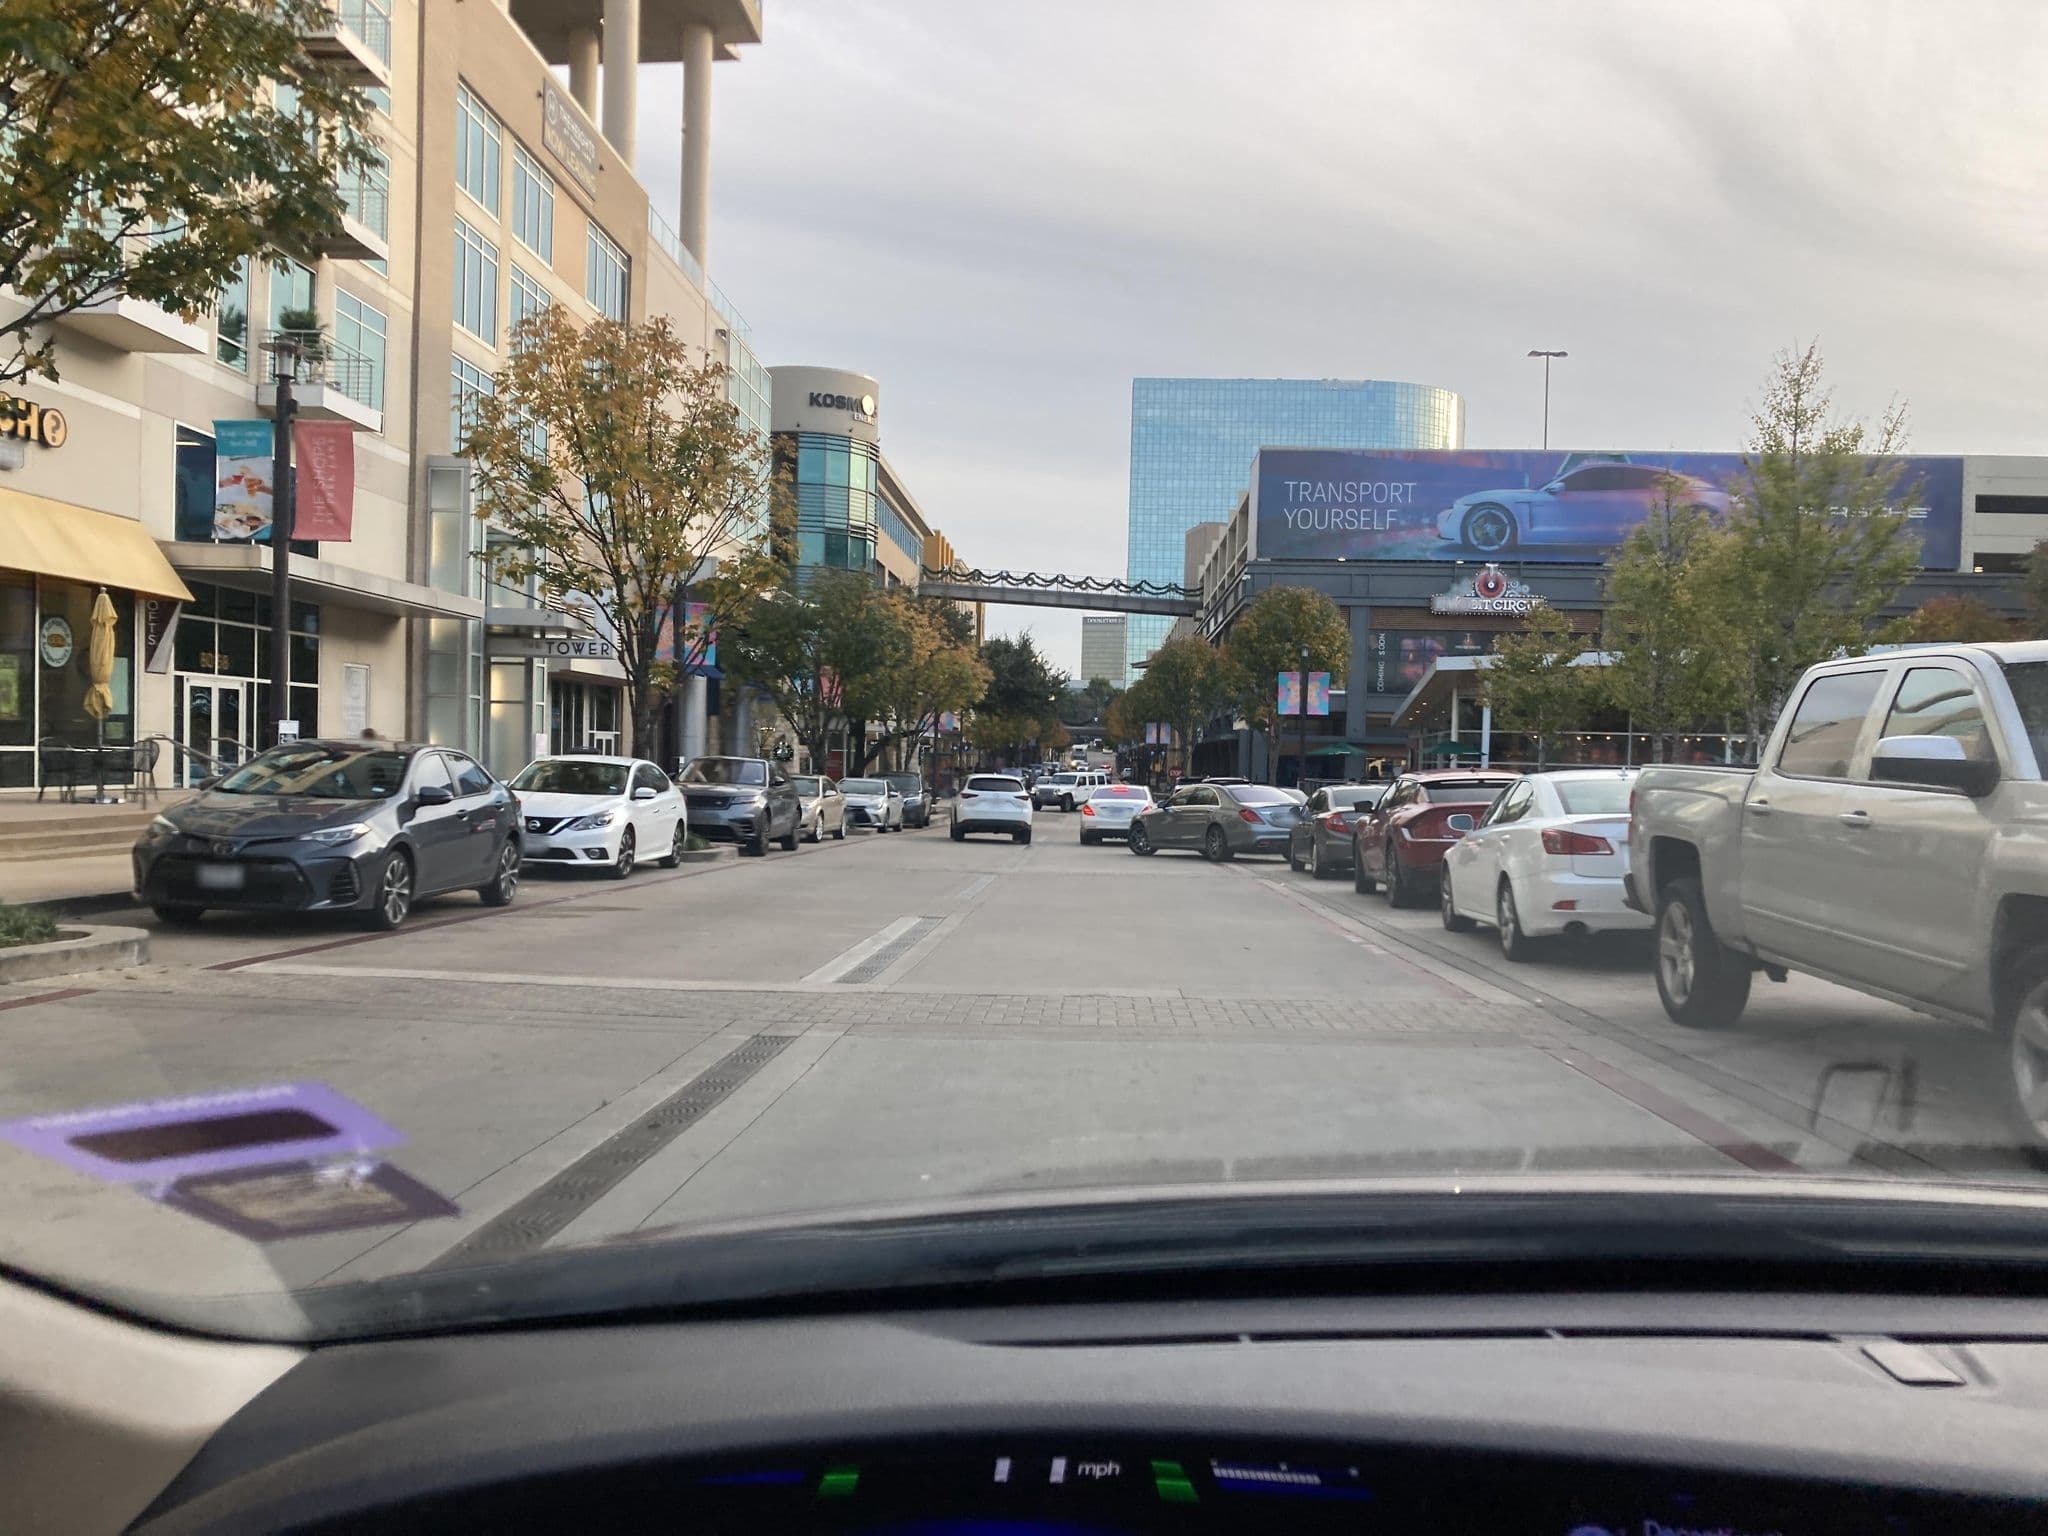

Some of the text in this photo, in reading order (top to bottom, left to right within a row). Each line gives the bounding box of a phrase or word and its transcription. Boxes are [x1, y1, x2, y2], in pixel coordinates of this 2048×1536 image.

[1283, 481, 1417, 503] TRANSPORT
[1283, 508, 1398, 530] YOURSELF
[546, 642, 610, 655] TOWER
[1378, 633, 1386, 655] SOON
[1078, 1461, 1120, 1480] mph
